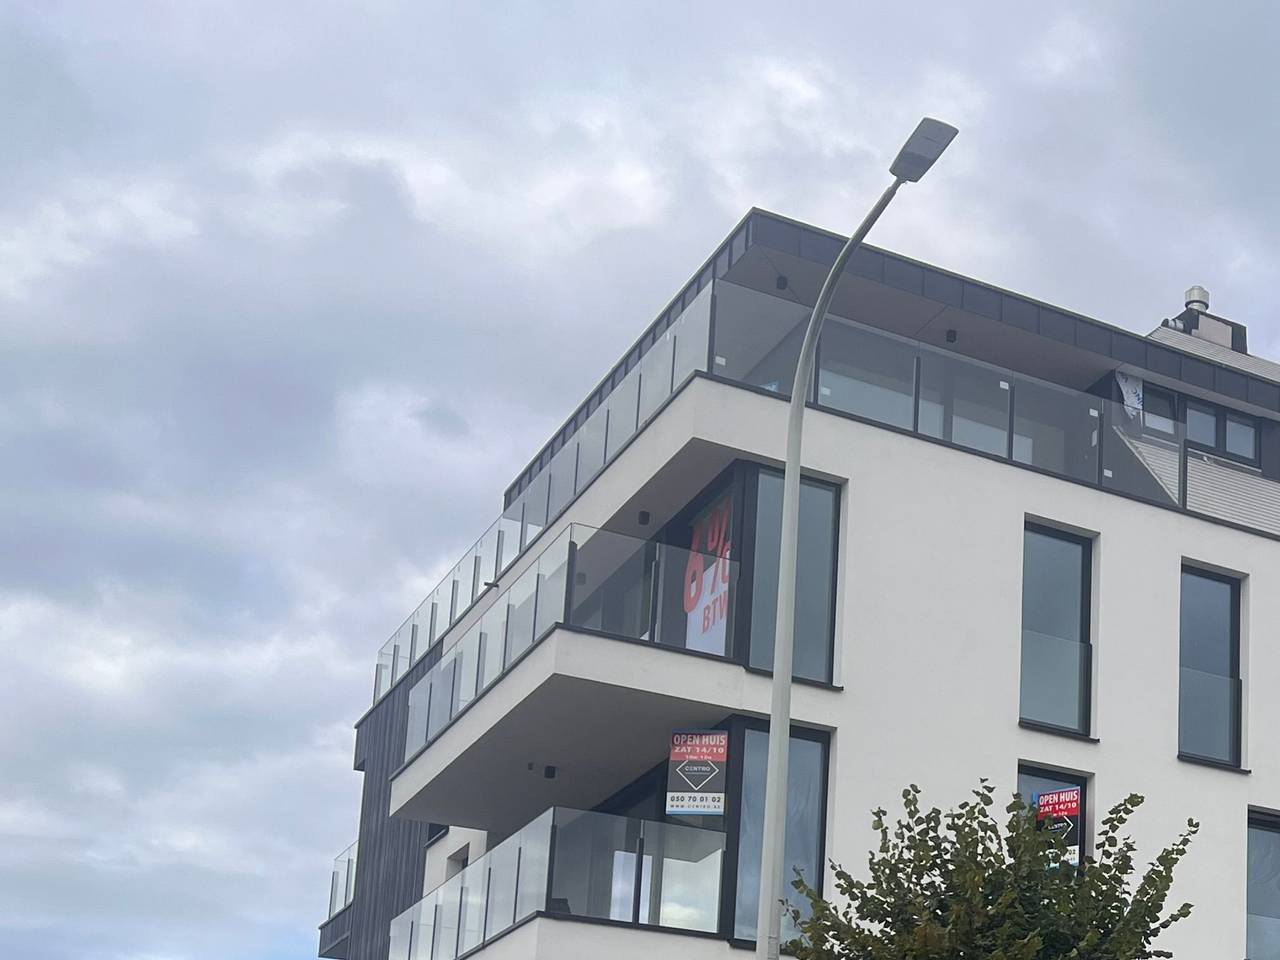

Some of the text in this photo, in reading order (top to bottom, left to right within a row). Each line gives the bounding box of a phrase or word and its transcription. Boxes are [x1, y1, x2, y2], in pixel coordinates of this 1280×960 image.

[673, 734, 726, 746] OPEN HUIS
[695, 746, 725, 754] 14/10
[1038, 790, 1078, 806] OPEN HUIS
[1039, 802, 1077, 813] ZAT 14/10
